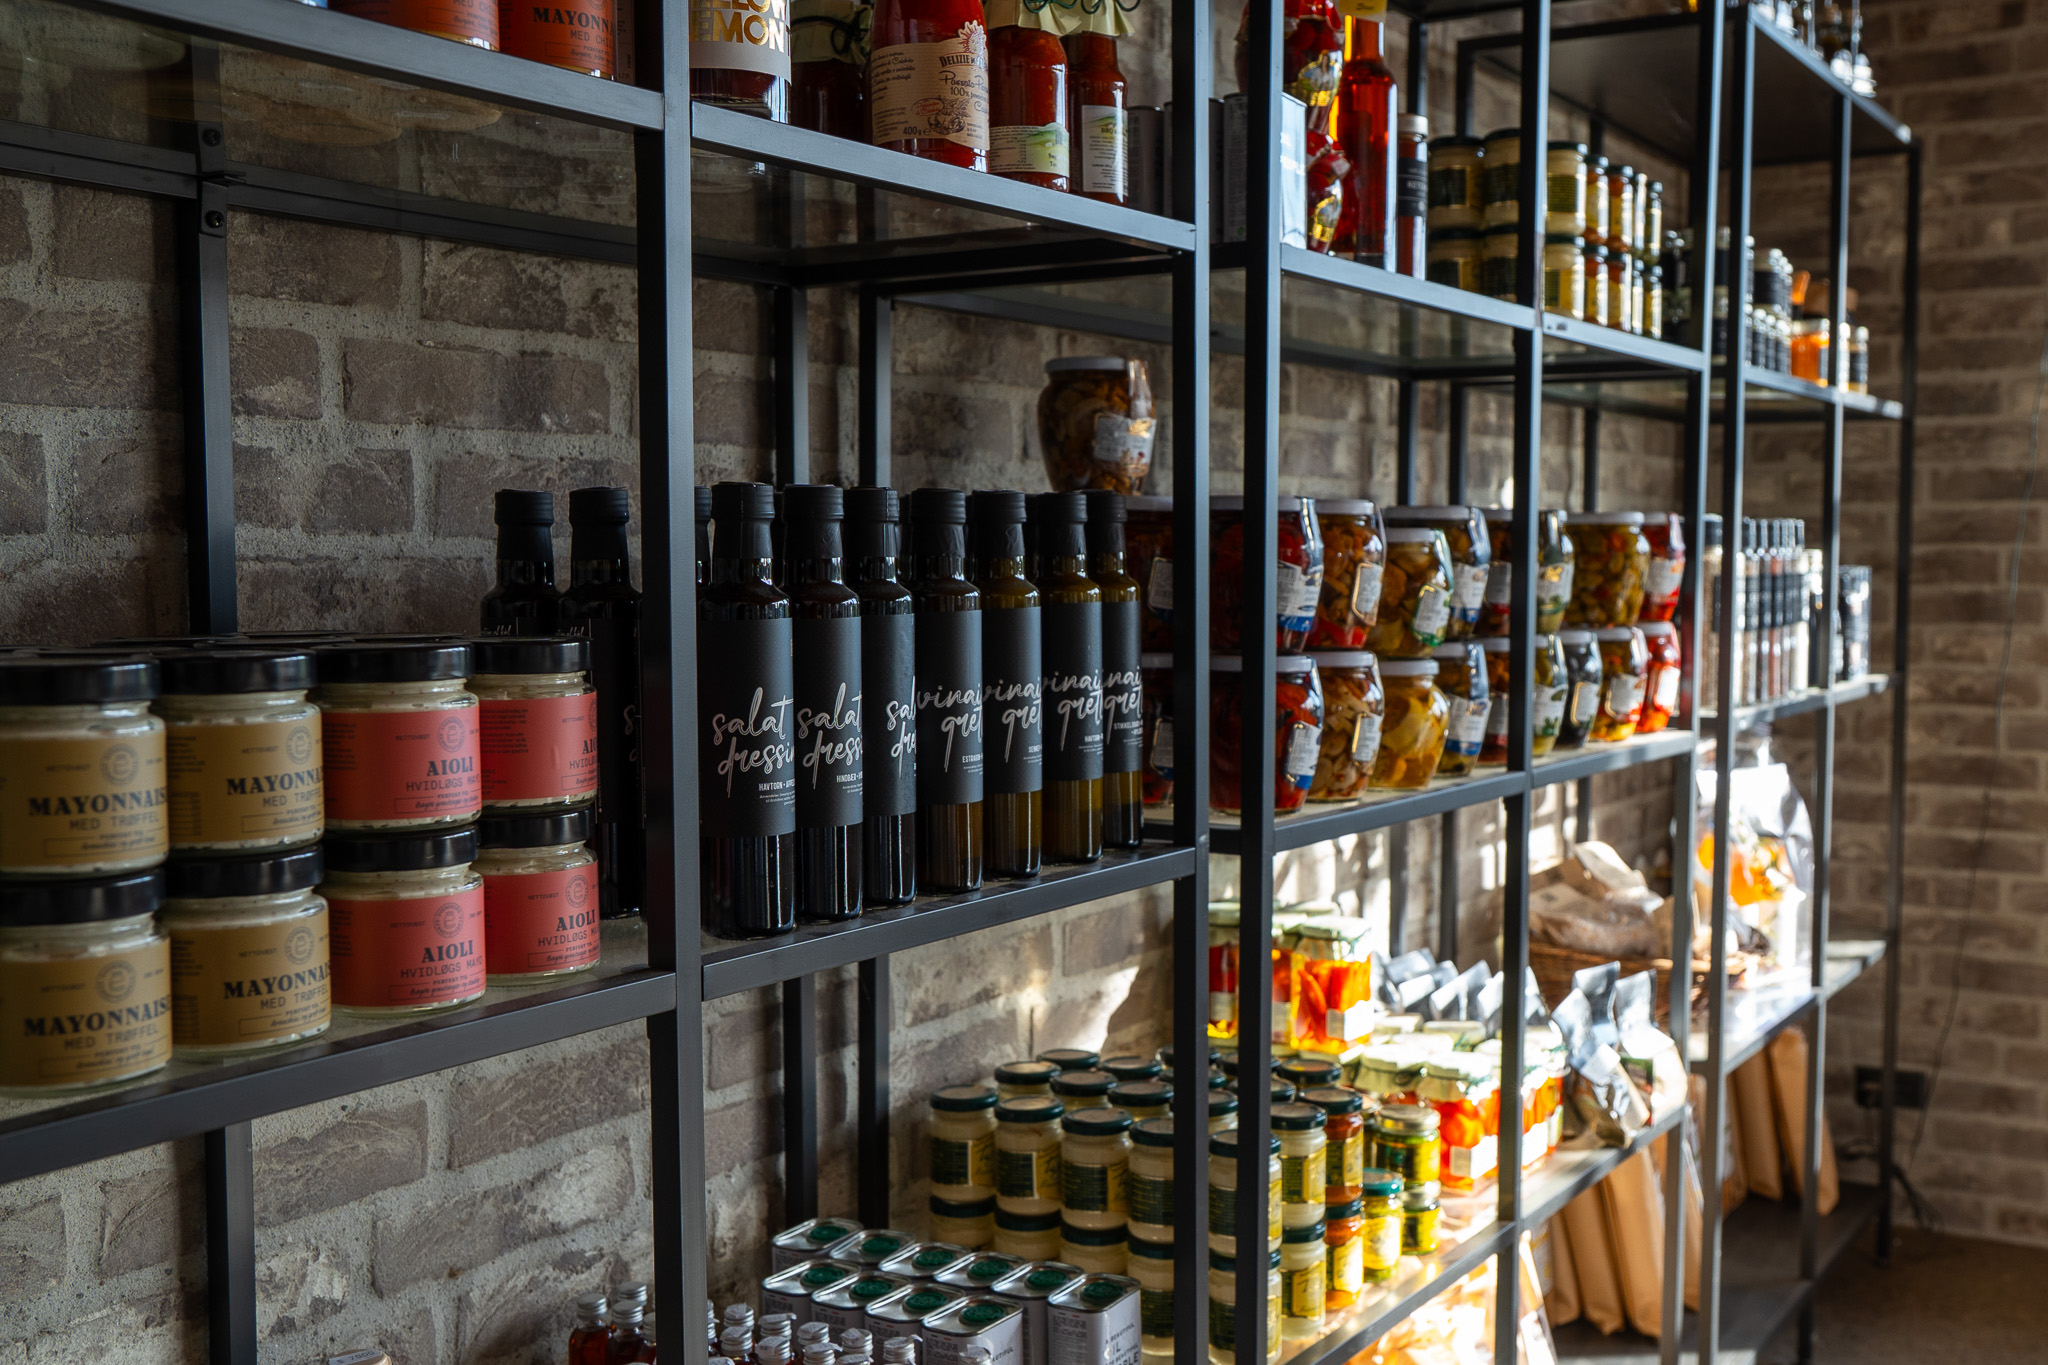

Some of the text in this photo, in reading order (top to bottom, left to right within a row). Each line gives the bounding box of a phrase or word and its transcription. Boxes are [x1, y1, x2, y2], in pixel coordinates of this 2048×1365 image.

[570, 29, 590, 42] MED
[939, 54, 970, 67] DELIZIE
[712, 686, 793, 746] salat
[427, 756, 474, 777] AIOLI
[406, 778, 463, 793] HVIDLØGS
[262, 795, 287, 808] MED
[69, 817, 100, 831] MED
[556, 909, 596, 932] AIOLI
[538, 930, 588, 947] HVIDLØGS
[422, 940, 474, 963] AIOLI
[400, 961, 462, 979] HVIDLØGS
[260, 996, 286, 1010] MED
[64, 1036, 96, 1051] MED
